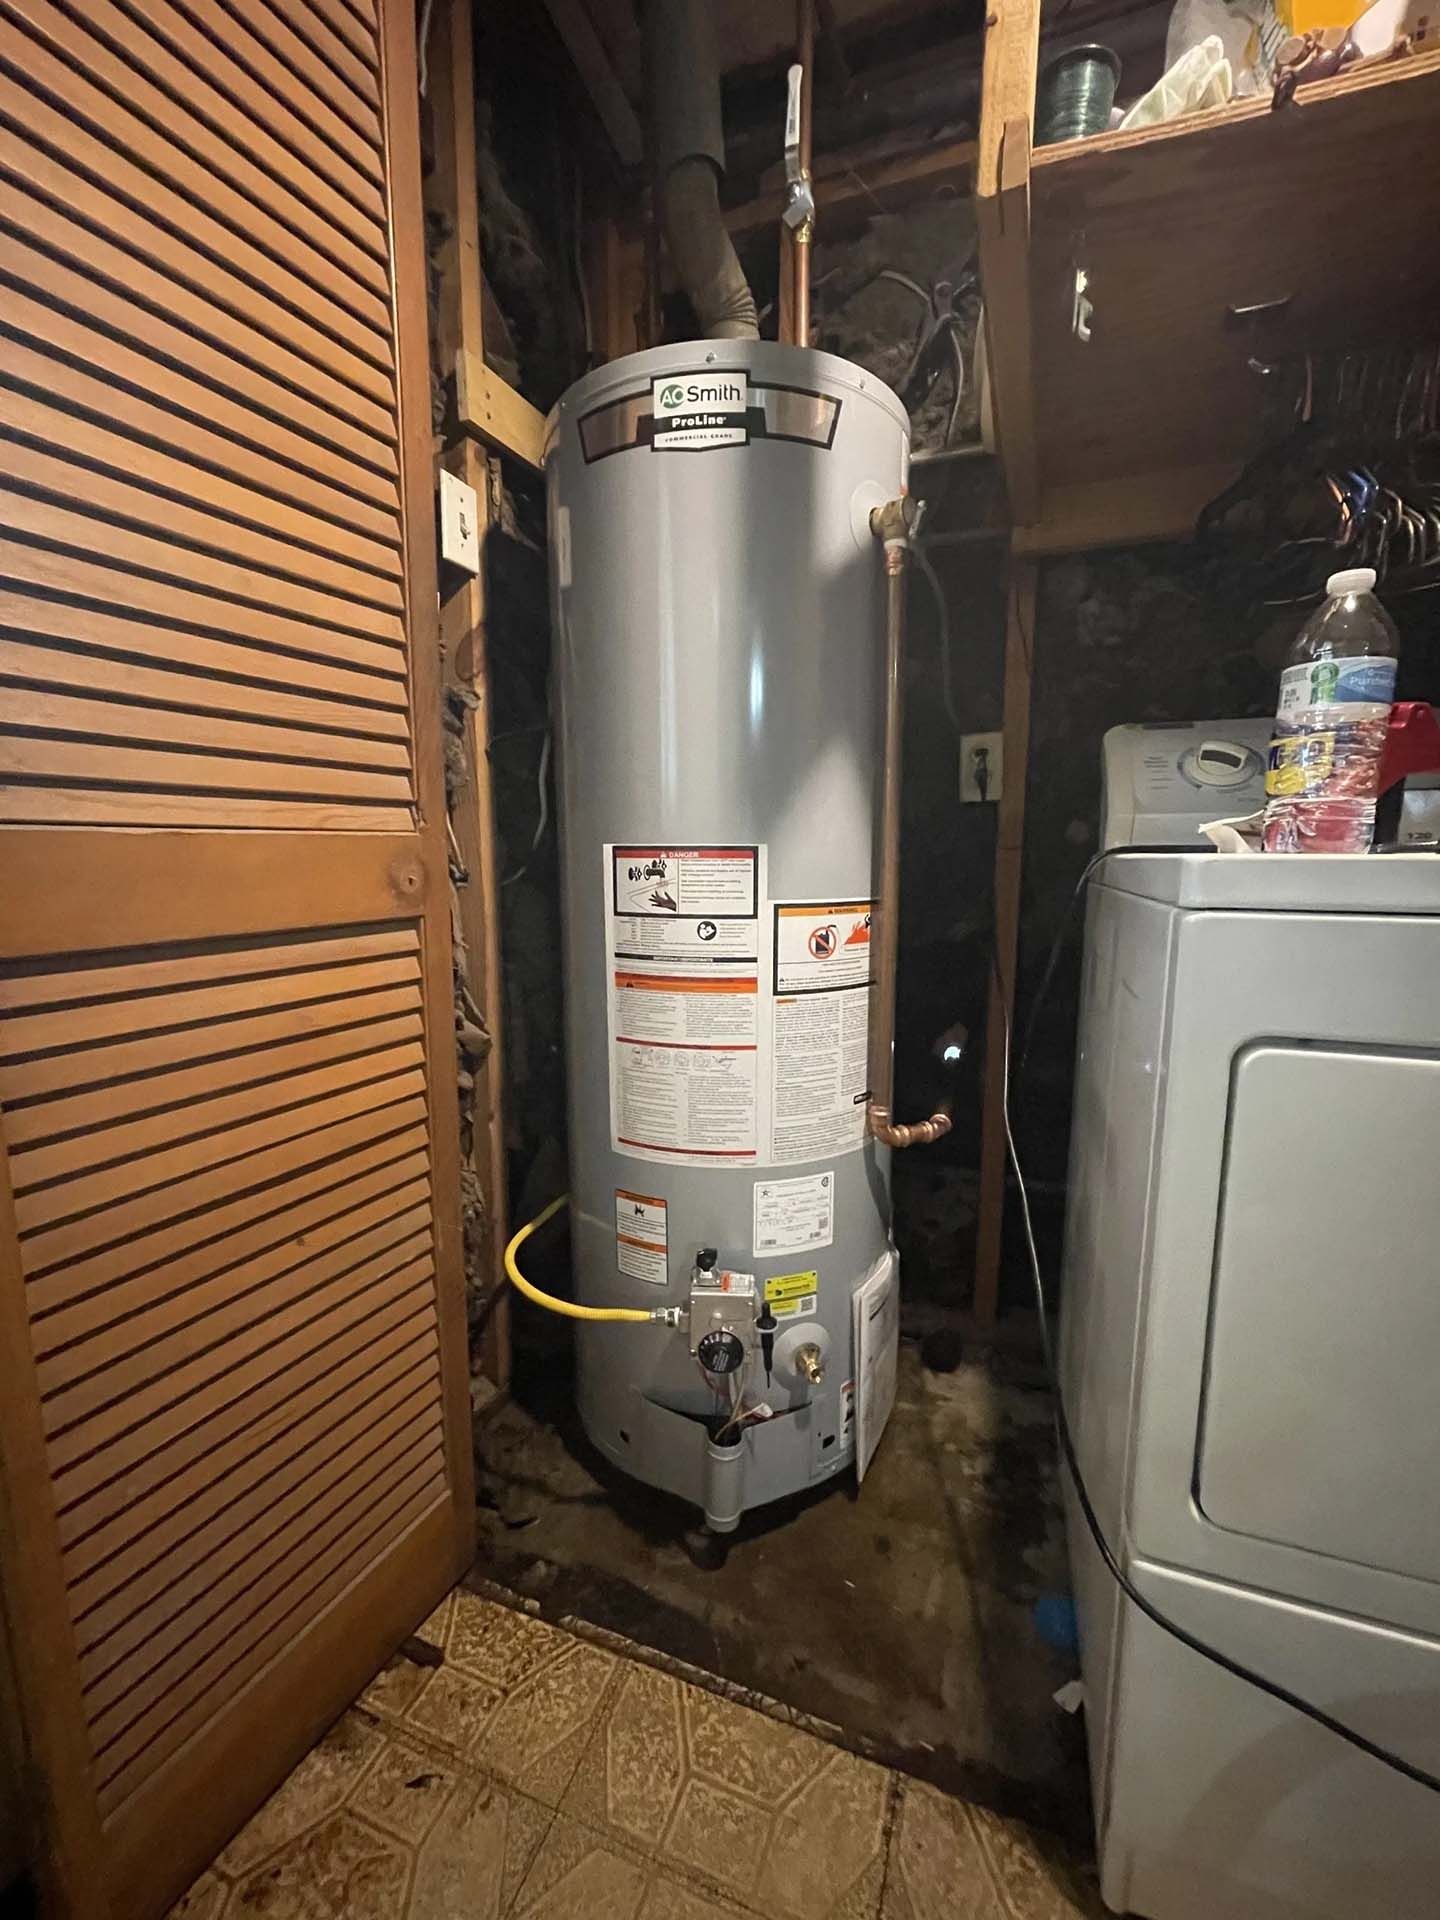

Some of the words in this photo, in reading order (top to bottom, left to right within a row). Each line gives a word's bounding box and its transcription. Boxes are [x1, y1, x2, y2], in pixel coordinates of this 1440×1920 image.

[687, 383, 741, 402] Smith
[671, 414, 725, 428] ProLine
[668, 850, 700, 859] DANGER
